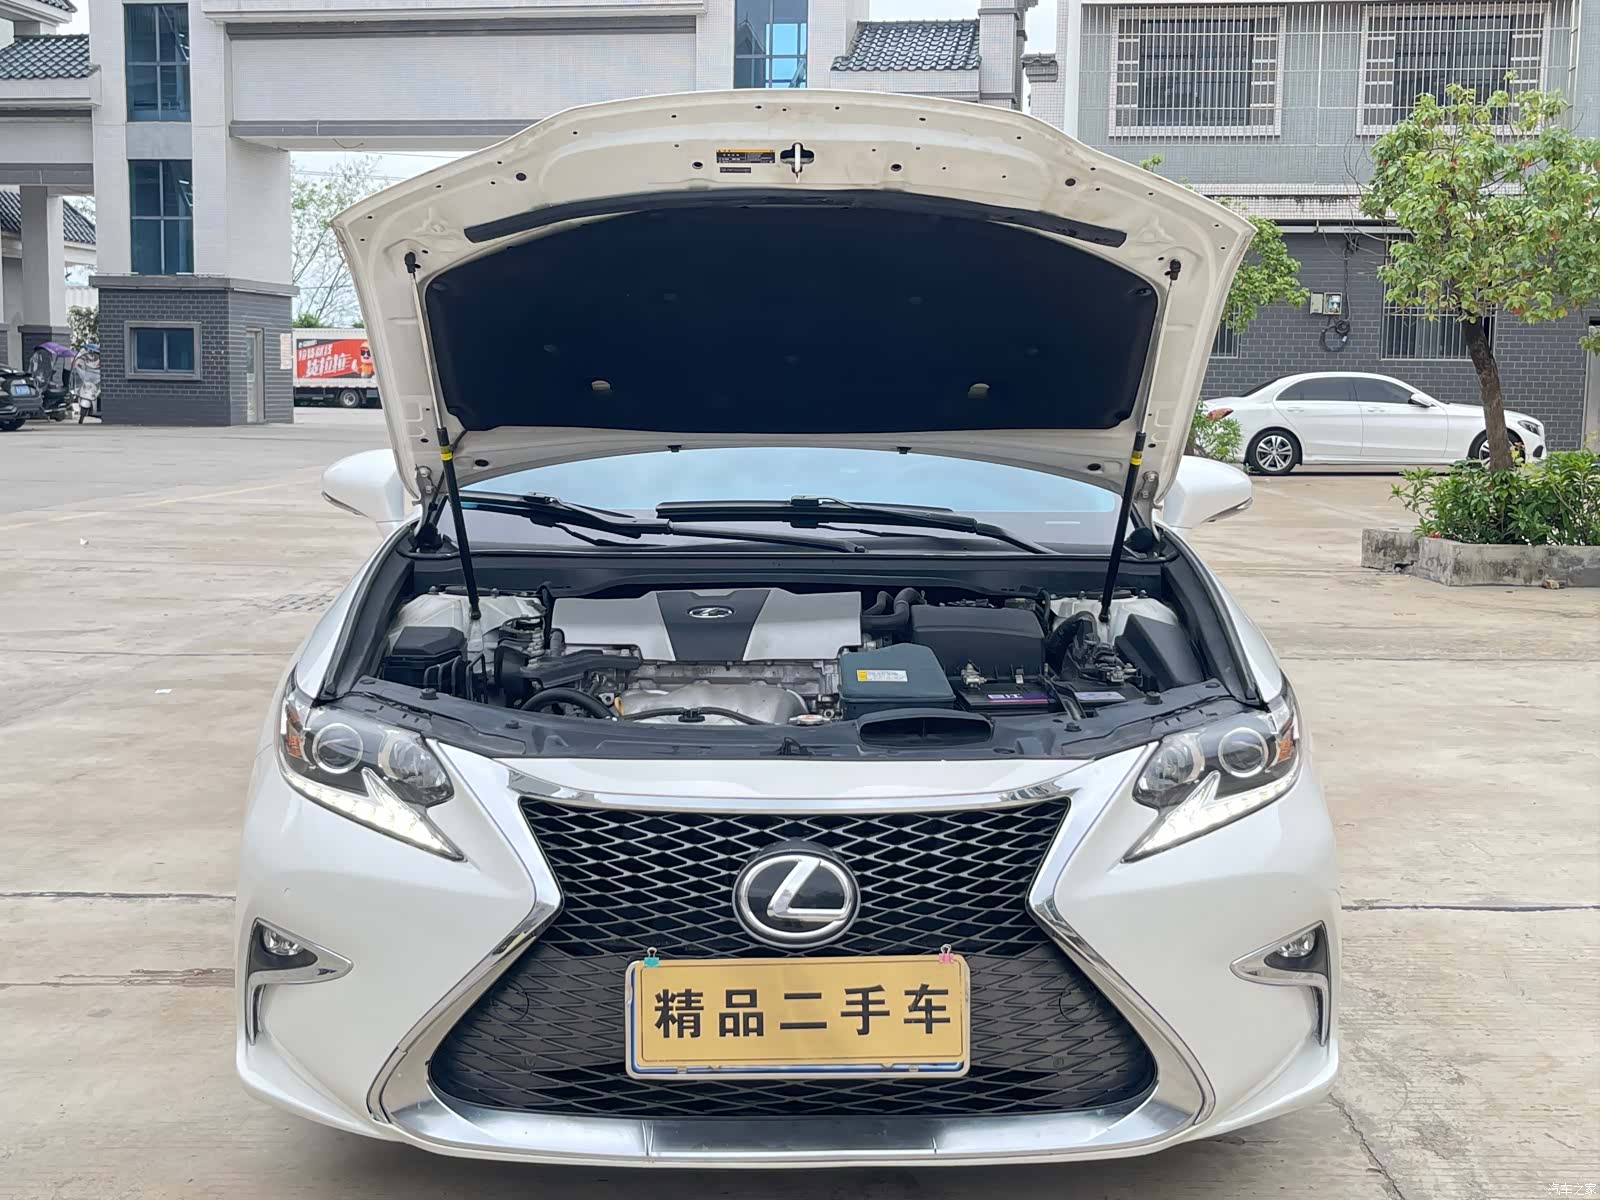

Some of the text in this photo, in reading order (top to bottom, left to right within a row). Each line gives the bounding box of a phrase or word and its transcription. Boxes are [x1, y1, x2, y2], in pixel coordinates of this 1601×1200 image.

[306, 353, 346, 376] 货拉拉
[655, 984, 950, 1038] 精品二手车
